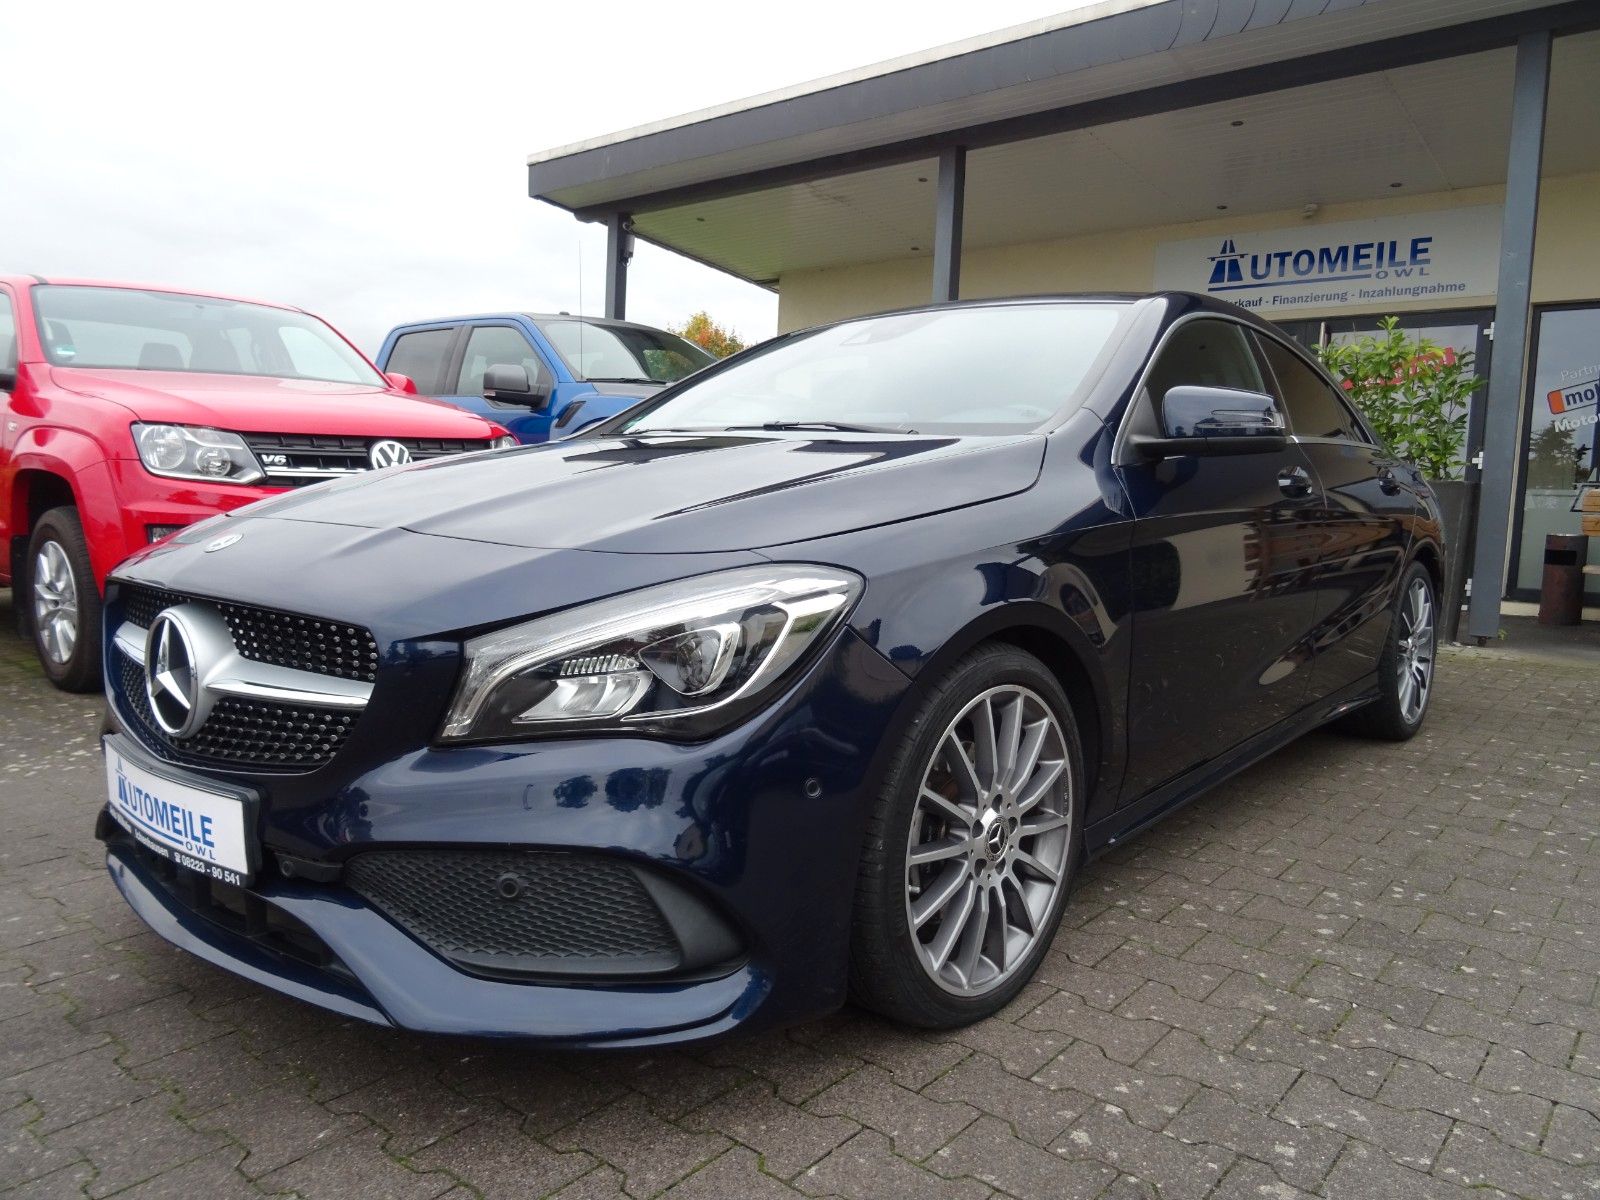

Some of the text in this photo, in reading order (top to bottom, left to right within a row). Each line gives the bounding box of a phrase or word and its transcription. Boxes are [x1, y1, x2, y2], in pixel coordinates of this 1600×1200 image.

[1376, 268, 1430, 279] OWL
[1272, 289, 1348, 306] Finanzierung
[1358, 282, 1466, 298] Inzahlungnahme
[261, 454, 287, 466] V6
[185, 841, 216, 860] OWL
[212, 866, 222, 879] 90
[224, 870, 240, 886] 541
